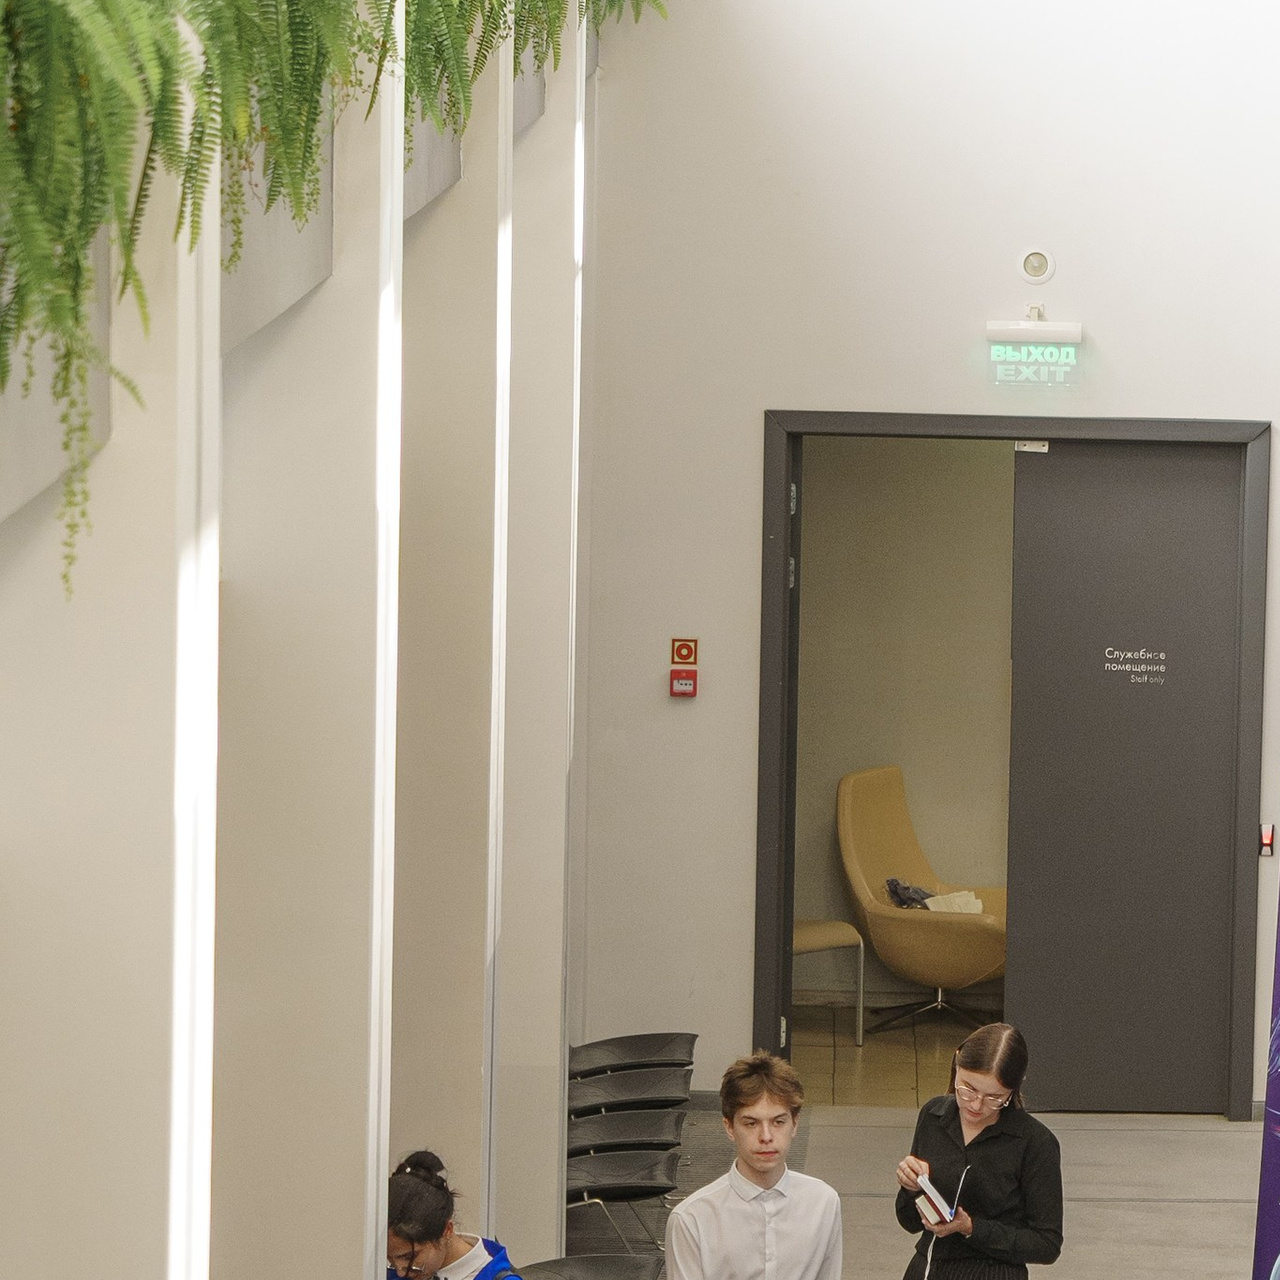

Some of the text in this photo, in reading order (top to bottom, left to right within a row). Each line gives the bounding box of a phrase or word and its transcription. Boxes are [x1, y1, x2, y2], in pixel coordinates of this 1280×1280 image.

[990, 345, 1077, 365] ВЫХОД
[996, 365, 1071, 382] EXIT
[1105, 647, 1166, 661] Служебное
[1104, 663, 1166, 672] помещение
